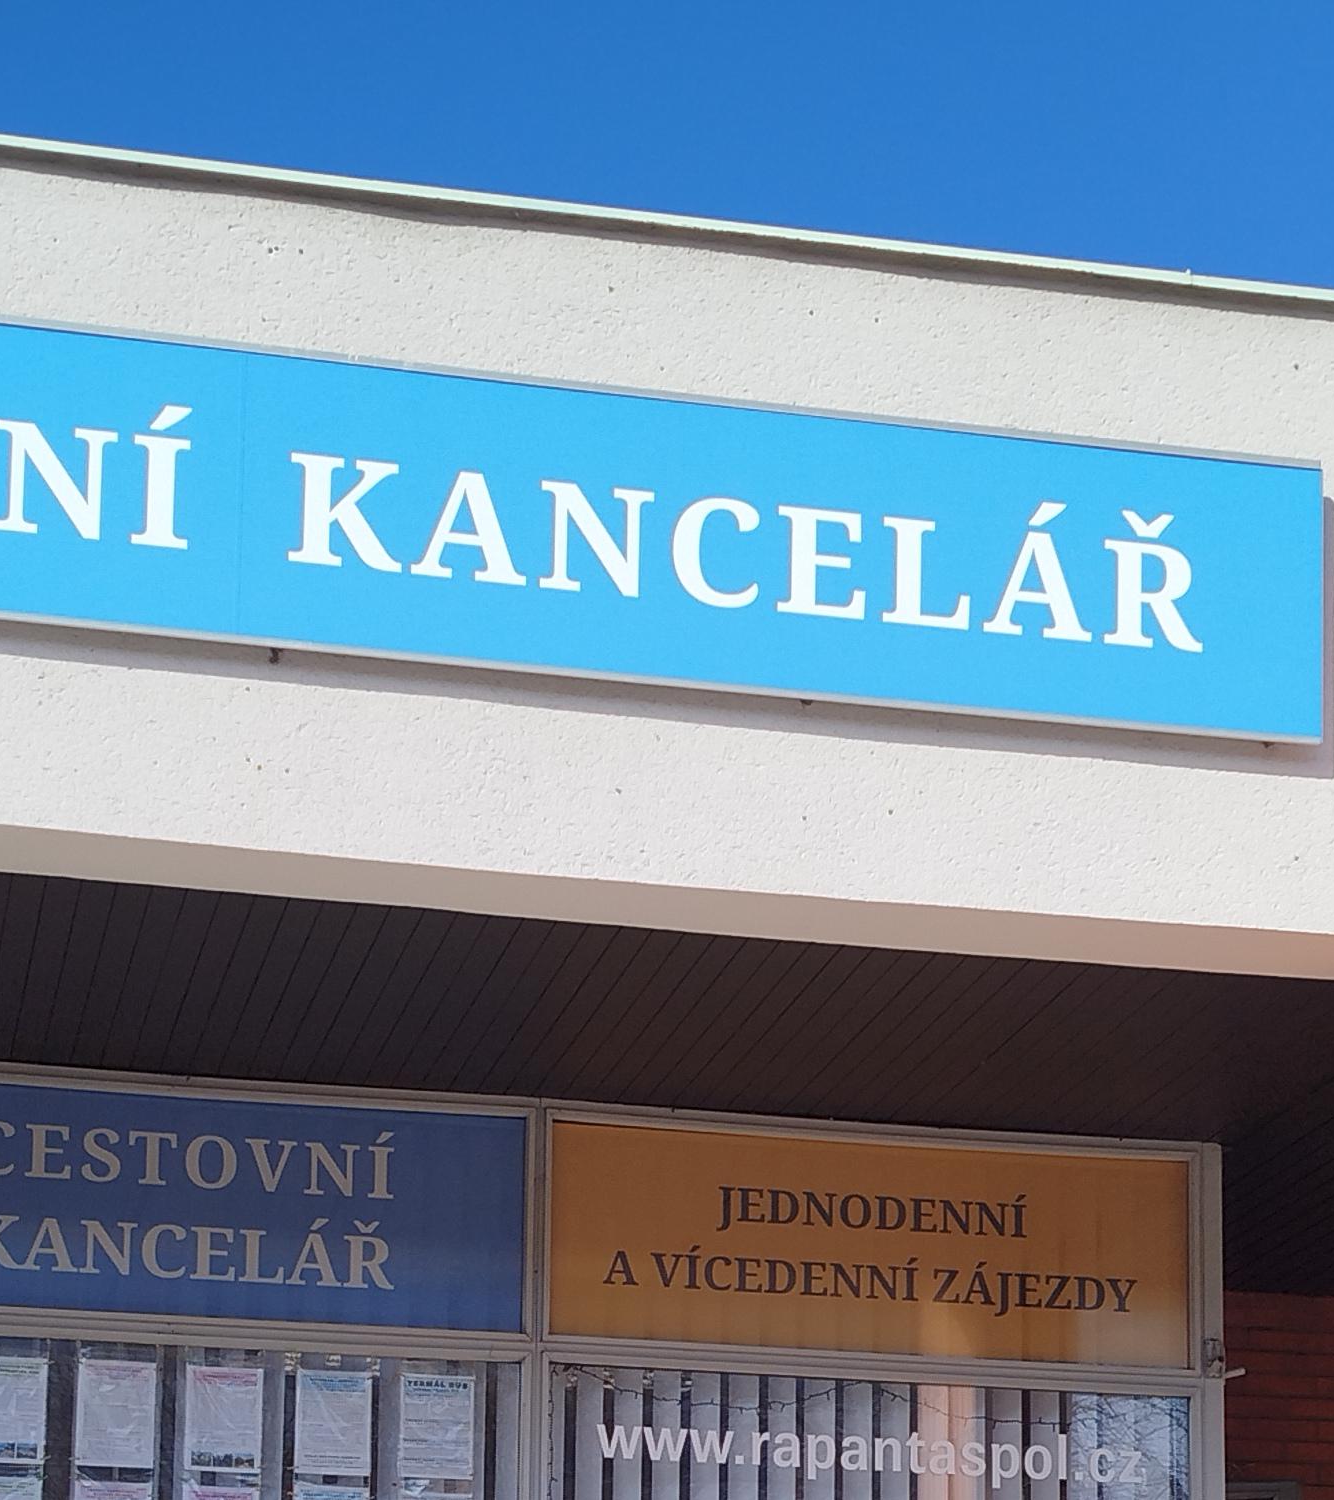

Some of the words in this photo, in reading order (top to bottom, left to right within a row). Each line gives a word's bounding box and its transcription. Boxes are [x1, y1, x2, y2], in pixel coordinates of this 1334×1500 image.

[285, 451, 1204, 653] KANCELÁŘ
[716, 1185, 1029, 1240] JEDNODENNÍ
[603, 1250, 640, 1287] A
[652, 1245, 920, 1302] VÍCEDENNÍ
[932, 1260, 1138, 1318] ZÁJEZDY
[596, 1423, 1145, 1489] www.rapantaspol.cz
